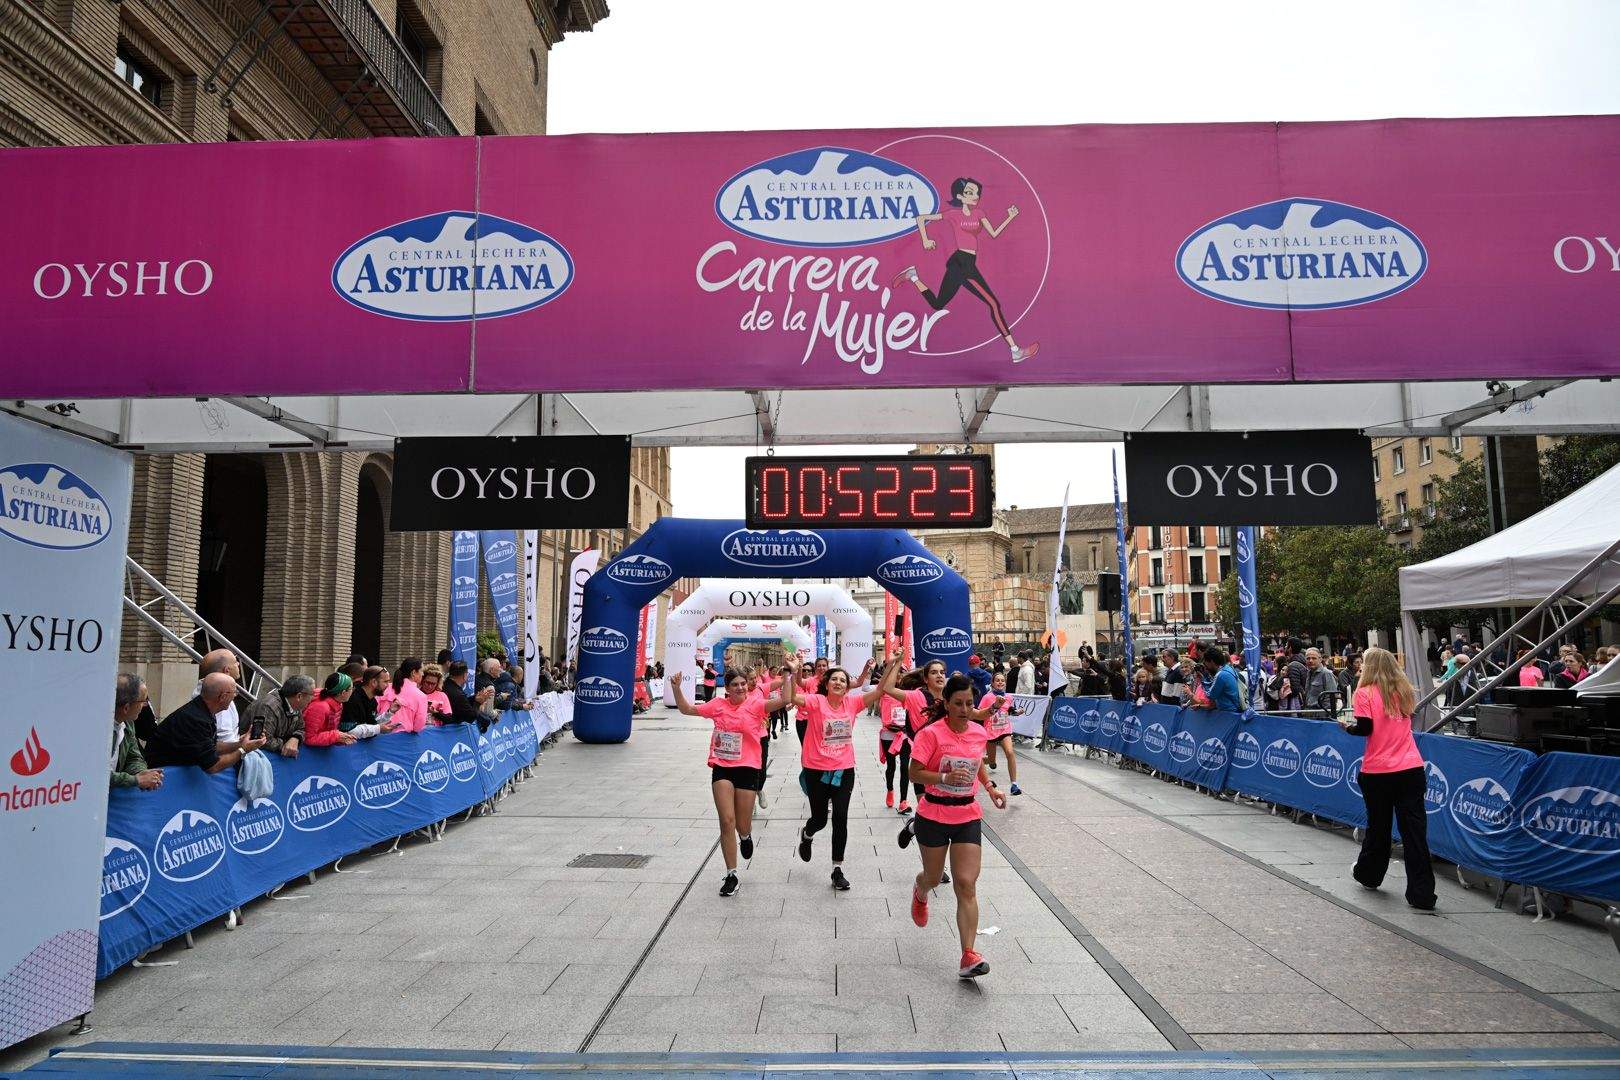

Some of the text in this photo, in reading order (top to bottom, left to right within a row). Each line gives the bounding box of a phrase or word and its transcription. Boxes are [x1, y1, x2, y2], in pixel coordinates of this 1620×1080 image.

[767, 181, 914, 192] CENTRAL LECHERA
[732, 184, 921, 221] ASTURIANA
[389, 247, 548, 261] CENTRAL LECHERA
[1234, 235, 1399, 248] CENTRAL LECHERA
[351, 252, 555, 294] ASTURIANA
[696, 241, 880, 293] Carrera
[1196, 241, 1409, 282] ASTURIANA
[33, 259, 213, 299] OYSHO
[740, 288, 950, 375] de la Mujer
[430, 466, 597, 502] OYSHO
[1166, 463, 1339, 498] OYSHO
[12, 485, 101, 512] CENTRAL LECHERA
[729, 537, 819, 557] ASTURIANA
[610, 565, 667, 578] ASTURIANA
[882, 566, 939, 578] ASTURIANA
[729, 590, 811, 608] OYSHO
[2, 613, 103, 653] YSHO
[581, 636, 625, 649] ASTURIANA
[576, 686, 620, 698] ASTURIANA
[1265, 750, 1297, 771] ASTURIANA
[1304, 757, 1340, 780] ASTURIANA
[418, 766, 448, 785] ASTURIANA
[360, 777, 408, 802] ASTURIANA
[292, 794, 348, 823] ASTURIANA
[231, 815, 281, 845] ASTURIANA
[162, 833, 224, 872] ASTURIANA
